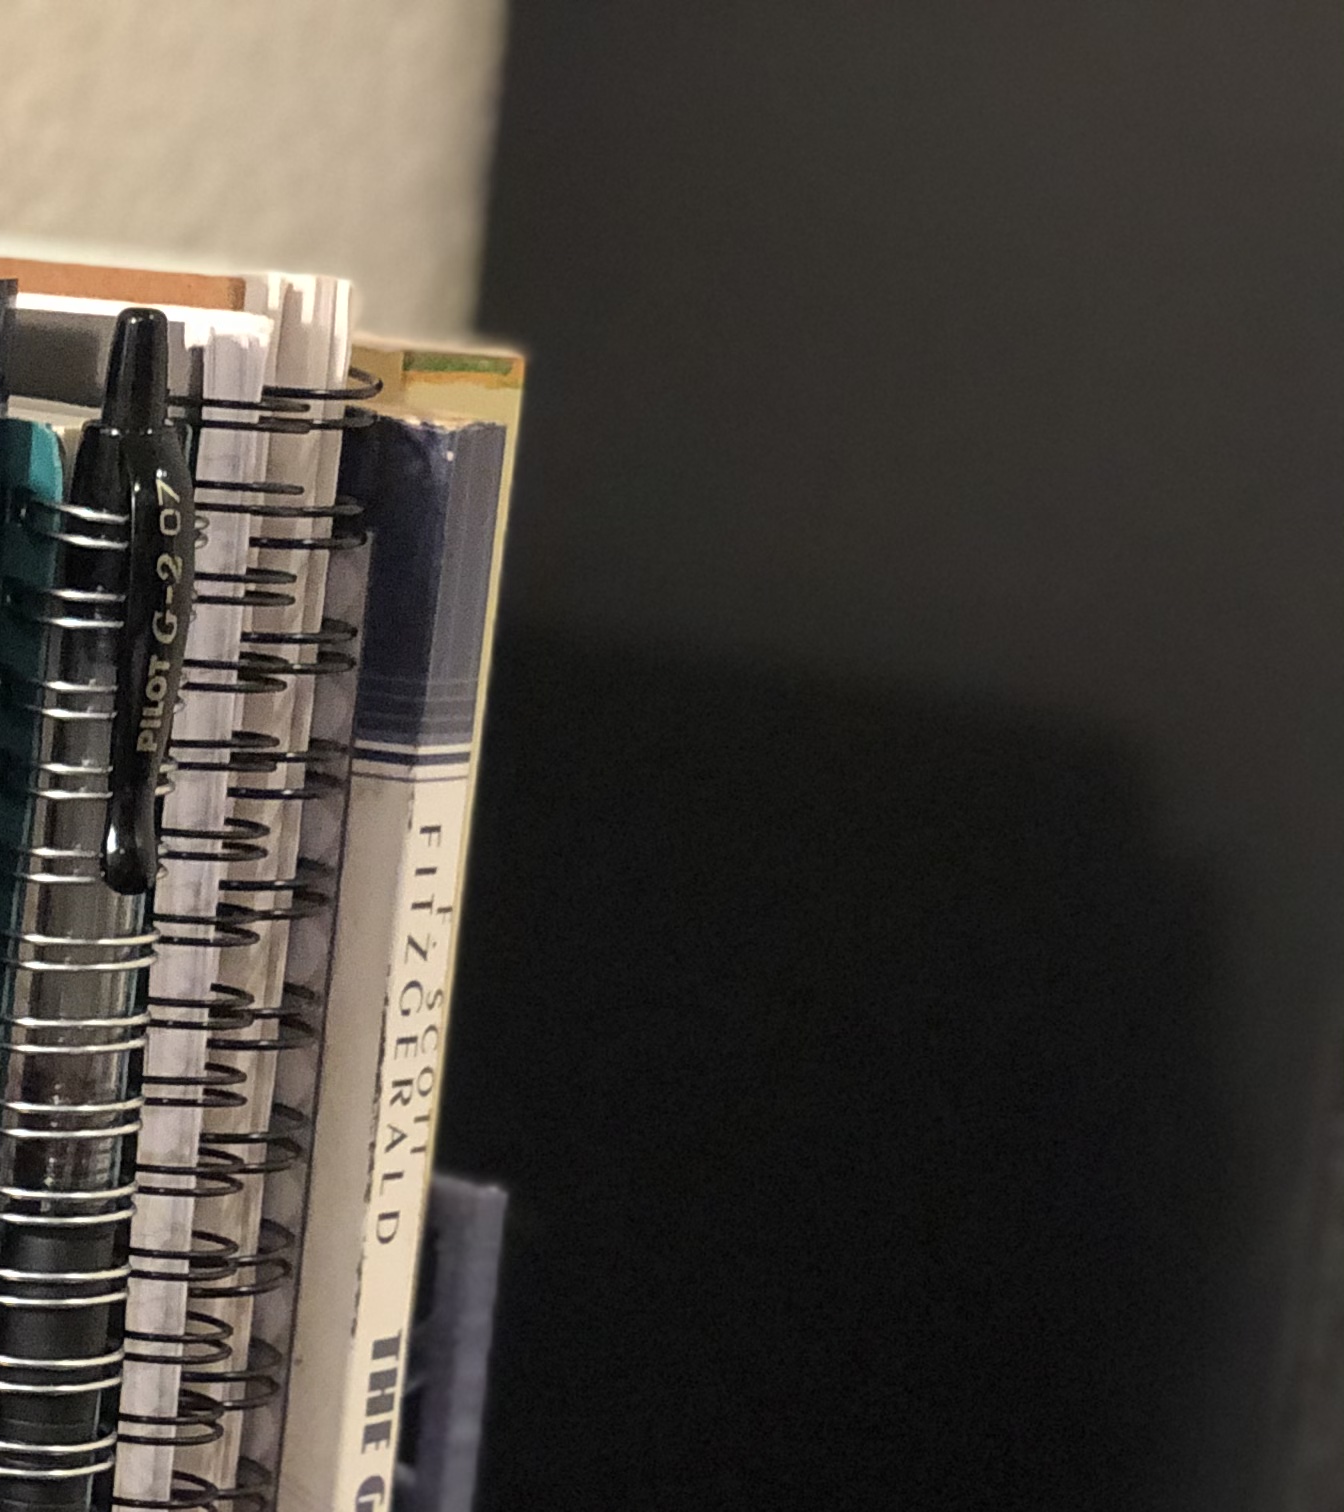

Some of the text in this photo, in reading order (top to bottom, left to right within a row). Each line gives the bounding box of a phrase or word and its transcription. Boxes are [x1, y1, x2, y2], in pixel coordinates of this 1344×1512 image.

[135, 478, 183, 753] PILOT G-2 07
[375, 823, 442, 1246] FITZGERALD
[361, 1330, 403, 1457] THE
